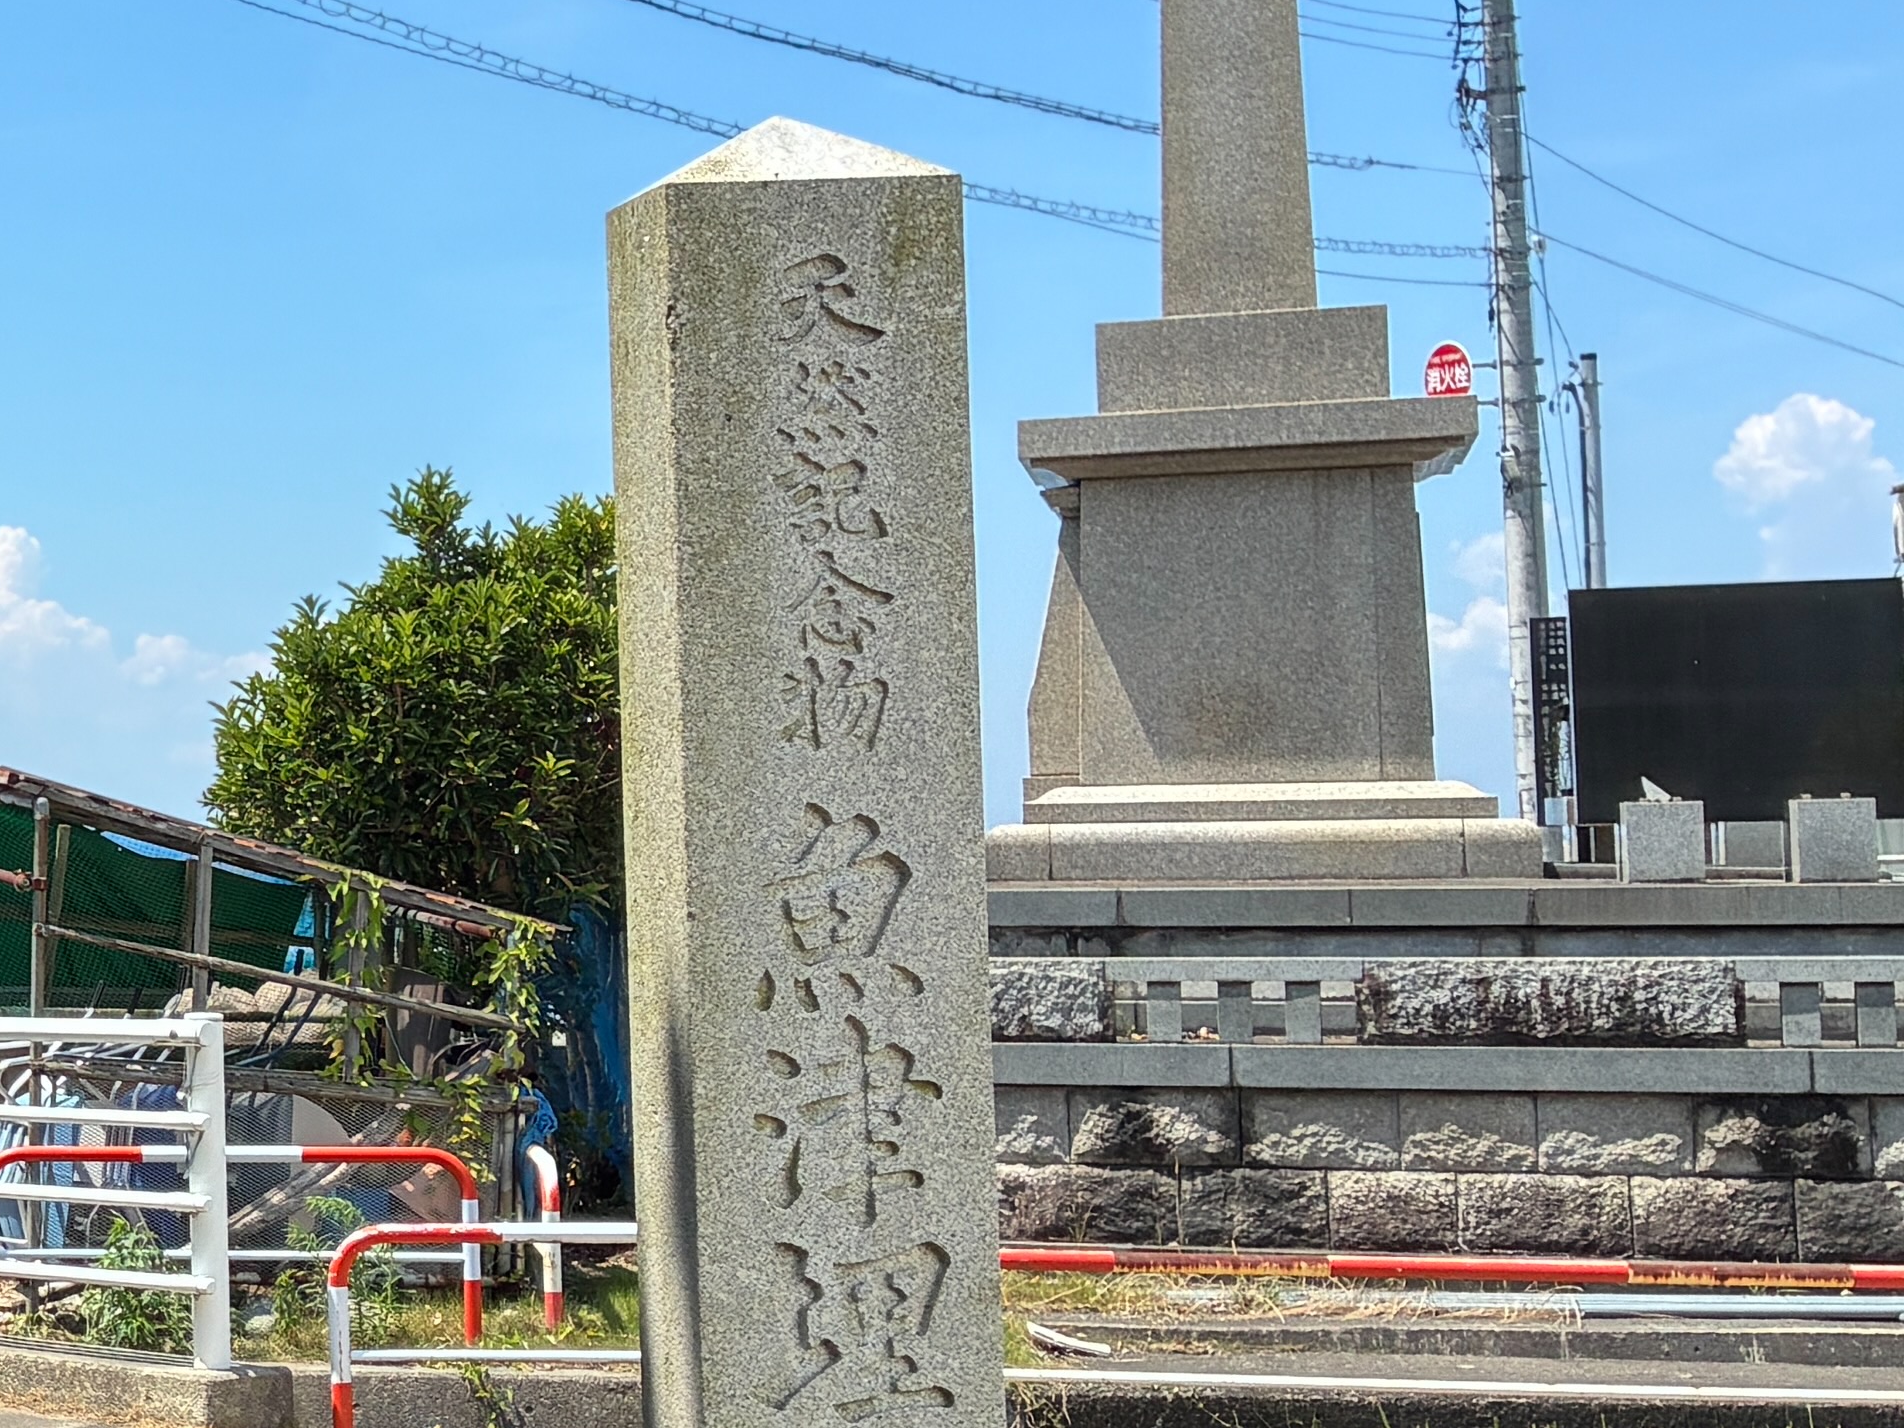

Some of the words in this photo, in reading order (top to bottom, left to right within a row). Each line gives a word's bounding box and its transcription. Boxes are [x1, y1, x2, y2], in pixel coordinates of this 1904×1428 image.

[775, 252, 896, 752] 天然記念物
[1426, 362, 1470, 394] 消火栓
